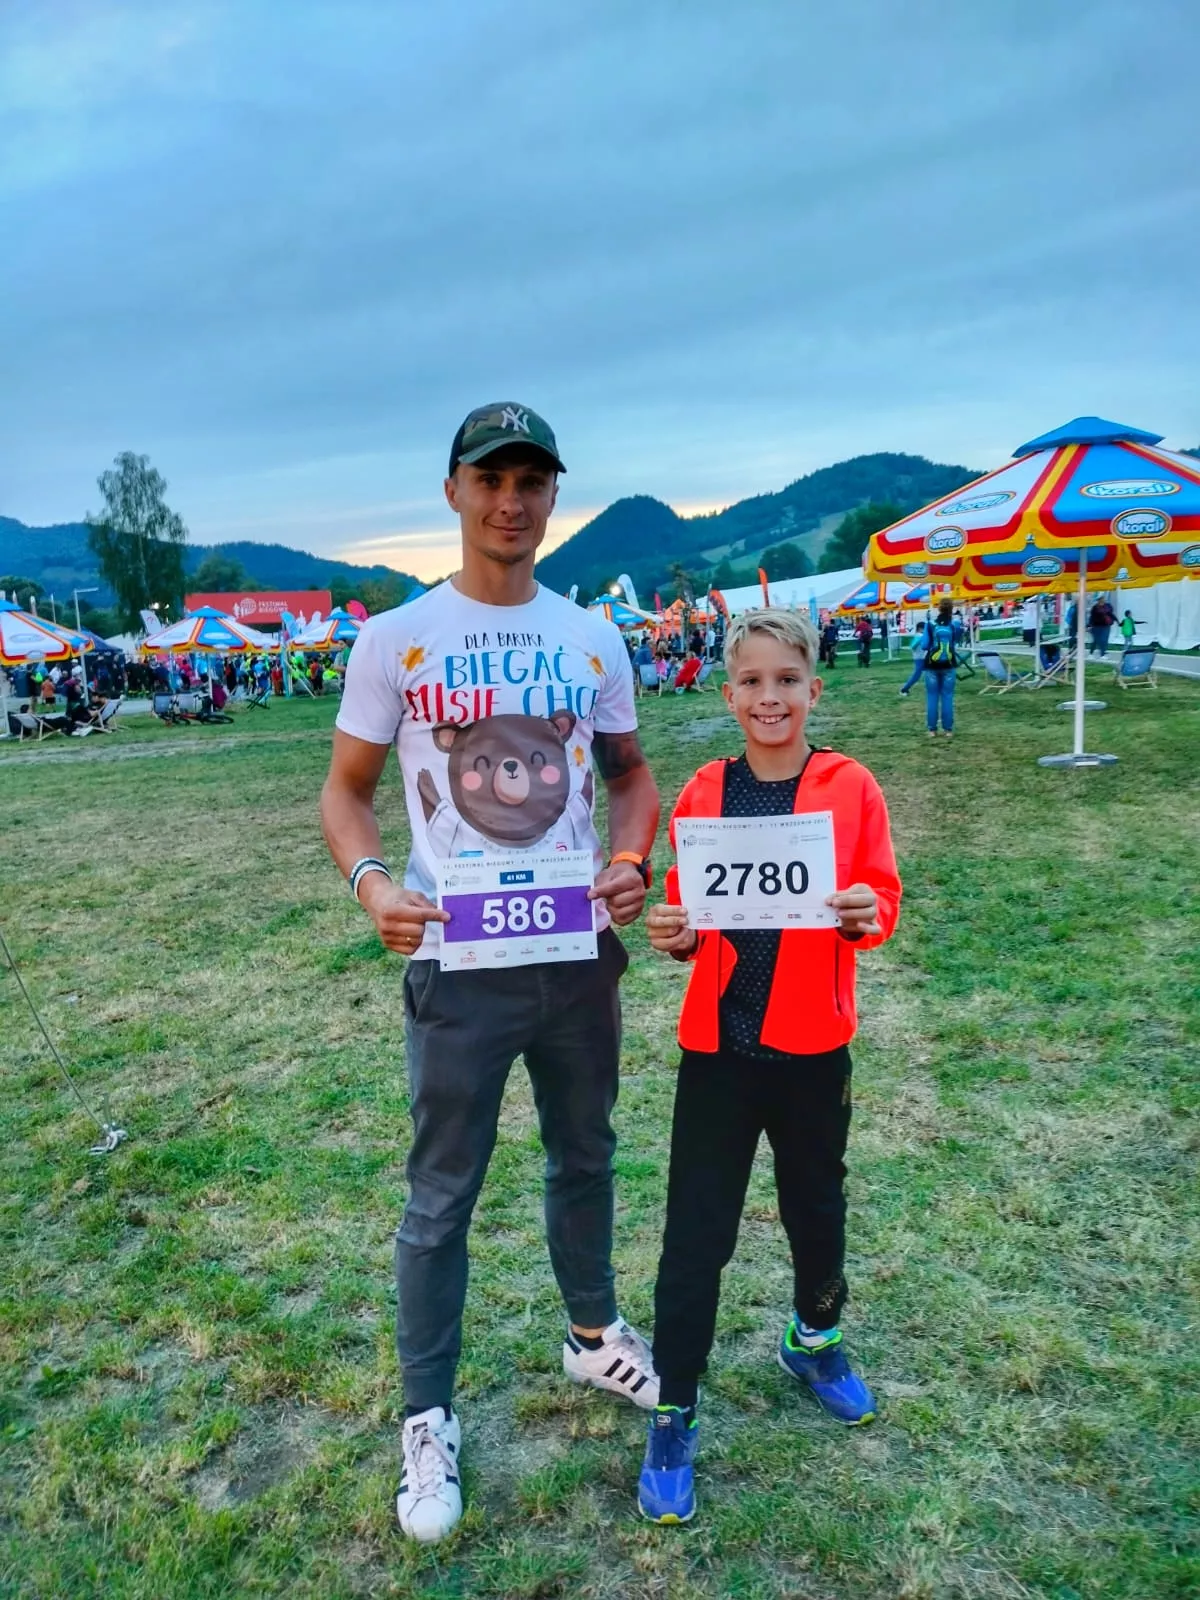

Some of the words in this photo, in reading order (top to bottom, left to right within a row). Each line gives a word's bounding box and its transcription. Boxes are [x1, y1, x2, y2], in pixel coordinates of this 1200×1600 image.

[1097, 484, 1162, 496] koral
[1122, 518, 1161, 534] koral
[932, 534, 959, 549] koral
[465, 632, 490, 649] DLA
[497, 632, 544, 647] BARTKA
[445, 645, 573, 689] BIEGAĆ
[515, 873, 527, 881] KM
[704, 860, 809, 897] 2780
[481, 894, 556, 935] 586
